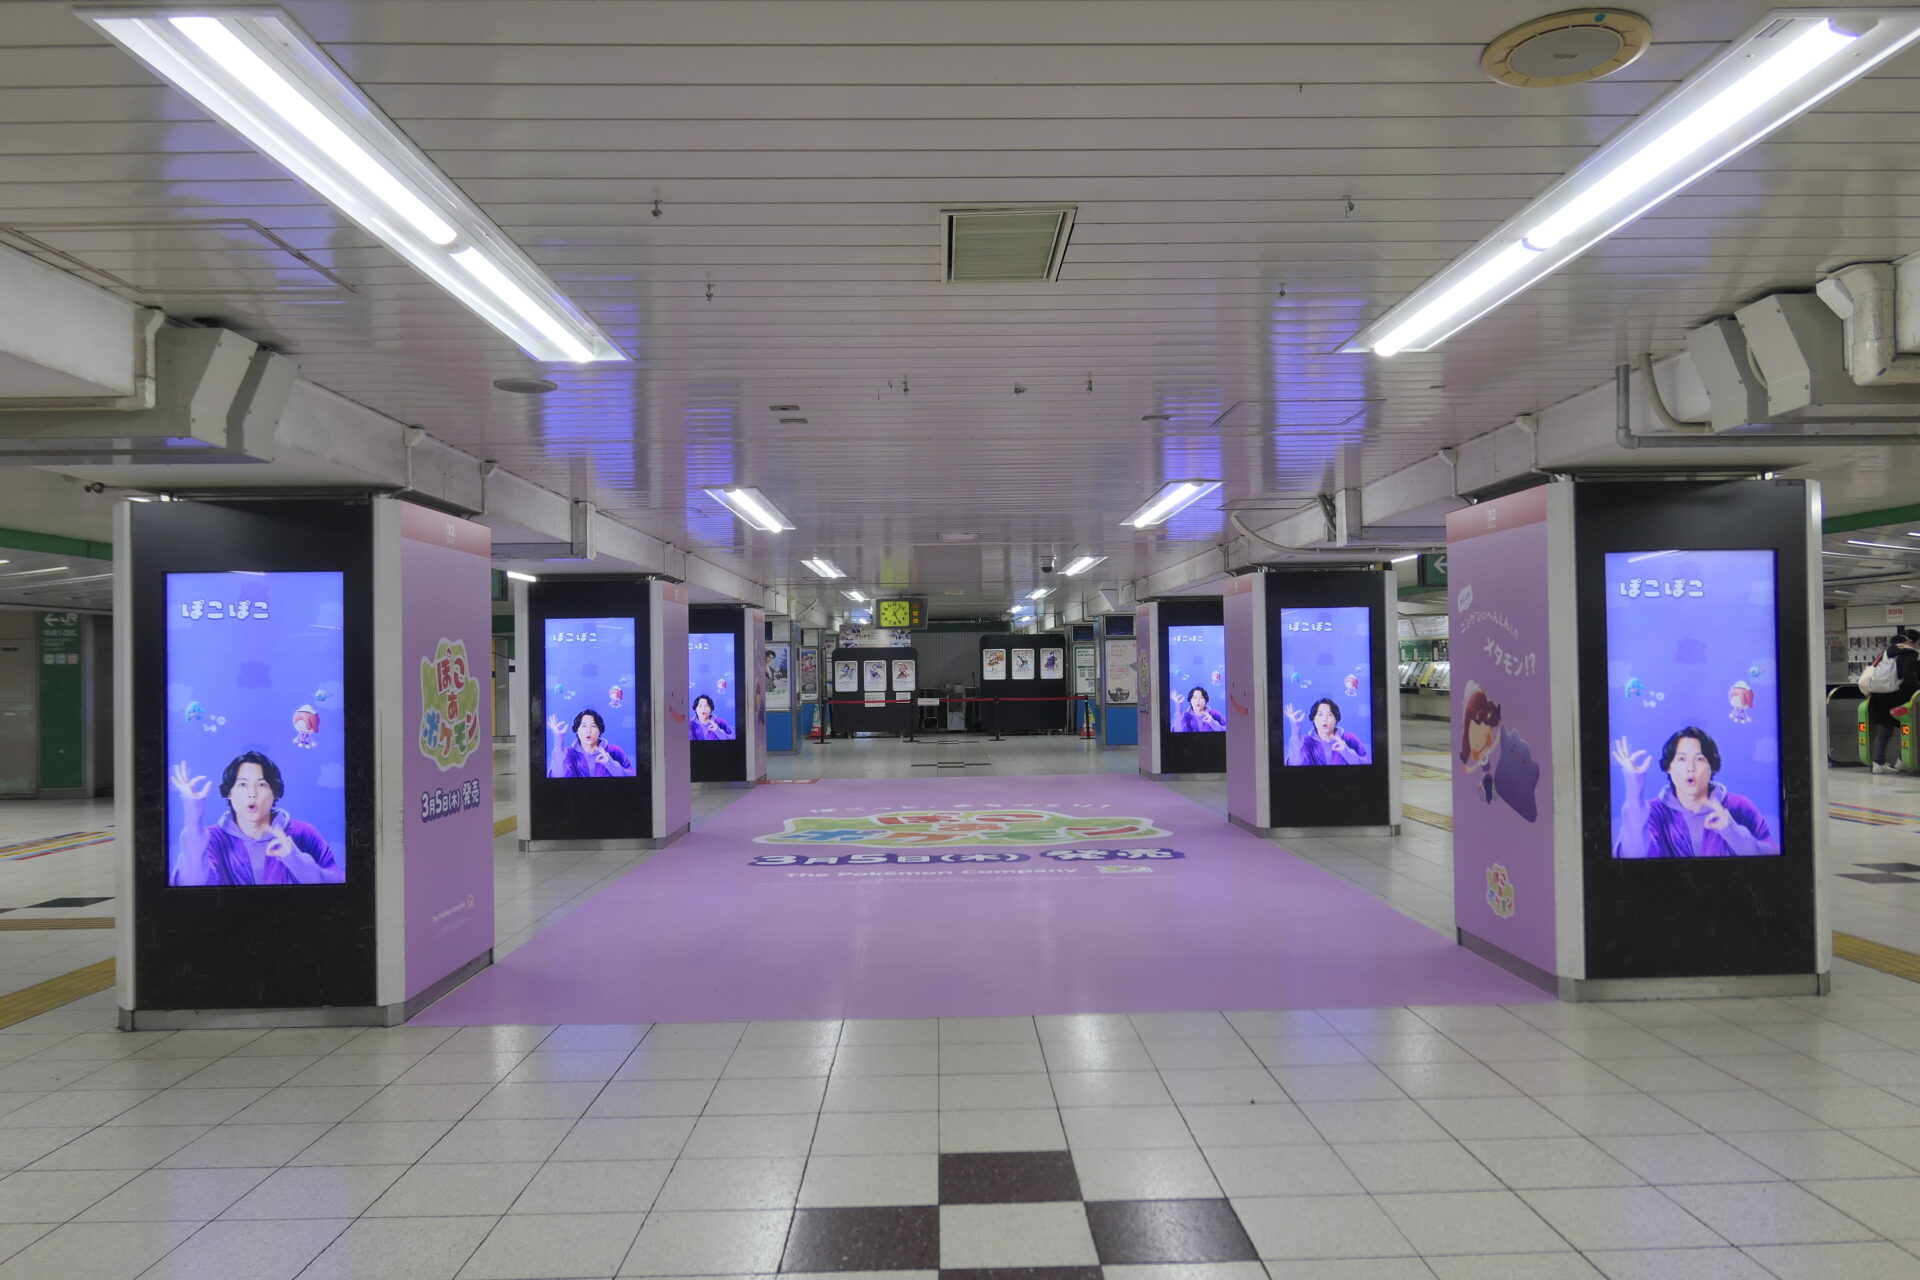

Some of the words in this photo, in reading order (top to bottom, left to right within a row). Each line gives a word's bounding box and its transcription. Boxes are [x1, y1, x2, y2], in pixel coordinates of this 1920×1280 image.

[1620, 577, 1704, 598] ぽこぽこ
[181, 599, 270, 620] ぽこぽこ
[422, 710, 478, 756] ポケモン
[462, 780, 480, 805] 発売
[776, 826, 1141, 842] ポケモン
[1046, 849, 1174, 860] 発売
[961, 867, 1078, 875] Company
